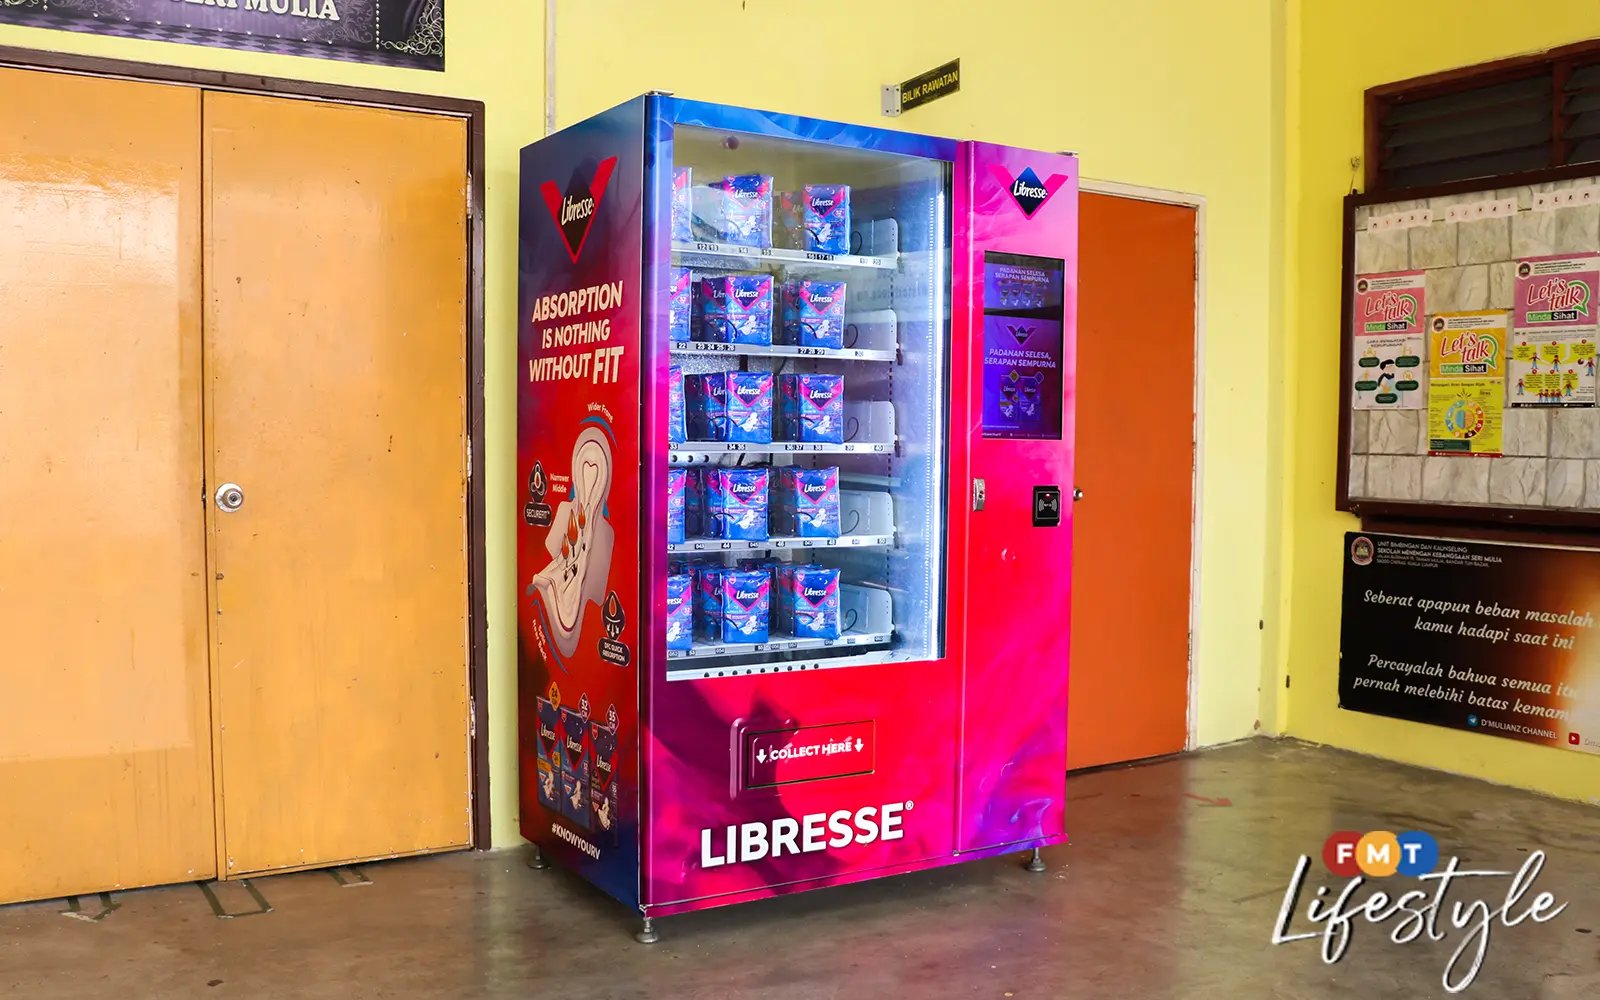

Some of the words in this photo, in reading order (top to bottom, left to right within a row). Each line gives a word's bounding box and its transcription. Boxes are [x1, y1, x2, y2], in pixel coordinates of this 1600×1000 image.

[902, 86, 921, 103] BILIK
[922, 71, 958, 95] RAWATAN
[1013, 180, 1048, 199] Libresse
[812, 197, 834, 207] Libresse
[561, 195, 594, 226] Libresse
[735, 289, 759, 298] Libresse
[810, 293, 833, 302] Libresse
[1528, 278, 1566, 305] Let's
[531, 280, 623, 322] ABSORPTION
[1365, 291, 1398, 316] Let's
[1550, 286, 1581, 311] talk
[1384, 300, 1409, 321] talk
[1553, 312, 1575, 320] Sihat
[1386, 322, 1405, 330] Sihat
[542, 328, 553, 349] IS
[554, 319, 611, 348] NOTHING
[1441, 332, 1476, 356] Let's
[989, 348, 1025, 358] PADANAN
[1461, 340, 1489, 363] talk
[529, 353, 592, 382] WITHOUT
[593, 346, 625, 385] FIT
[984, 358, 1017, 366] SERAPAN
[1018, 360, 1056, 368] SEMPURNA
[1464, 364, 1485, 372] Sihat
[713, 386, 726, 396] Libr
[737, 386, 761, 396] Libresse
[810, 389, 833, 399] Libresse
[587, 402, 602, 412] Wider
[550, 473, 570, 483] Narrower
[552, 484, 567, 493] Middle
[733, 484, 756, 493] Libresse
[804, 484, 827, 493] Libresse
[1432, 552, 1471, 560] KEBANGSAAN
[736, 590, 760, 599] Libresse
[804, 587, 827, 597] Libresse
[667, 596, 683, 605] resse
[1364, 589, 1414, 607] Seberat
[1417, 598, 1471, 614] apapun
[1475, 600, 1521, 619] beban
[1525, 610, 1594, 627] masalah
[1414, 616, 1453, 634] kamu
[1457, 621, 1511, 644] hadapi
[1513, 631, 1549, 646] saat
[1552, 633, 1576, 649] ini
[1367, 654, 1444, 677] Percayalah
[1447, 665, 1496, 686] bahwa
[1501, 677, 1552, 694] semua
[1353, 677, 1400, 692] pernah
[1404, 683, 1465, 703] melebihi
[1468, 690, 1509, 710] batas
[1513, 698, 1570, 720] kemam
[581, 699, 589, 711] 32
[608, 710, 617, 723] 35
[1481, 719, 1521, 733] D'MULIANZ
[1522, 726, 1558, 739] CHANNEL
[770, 745, 821, 761] COLLECT
[822, 740, 852, 755] HERE
[551, 822, 601, 860] #KNOWYOURV
